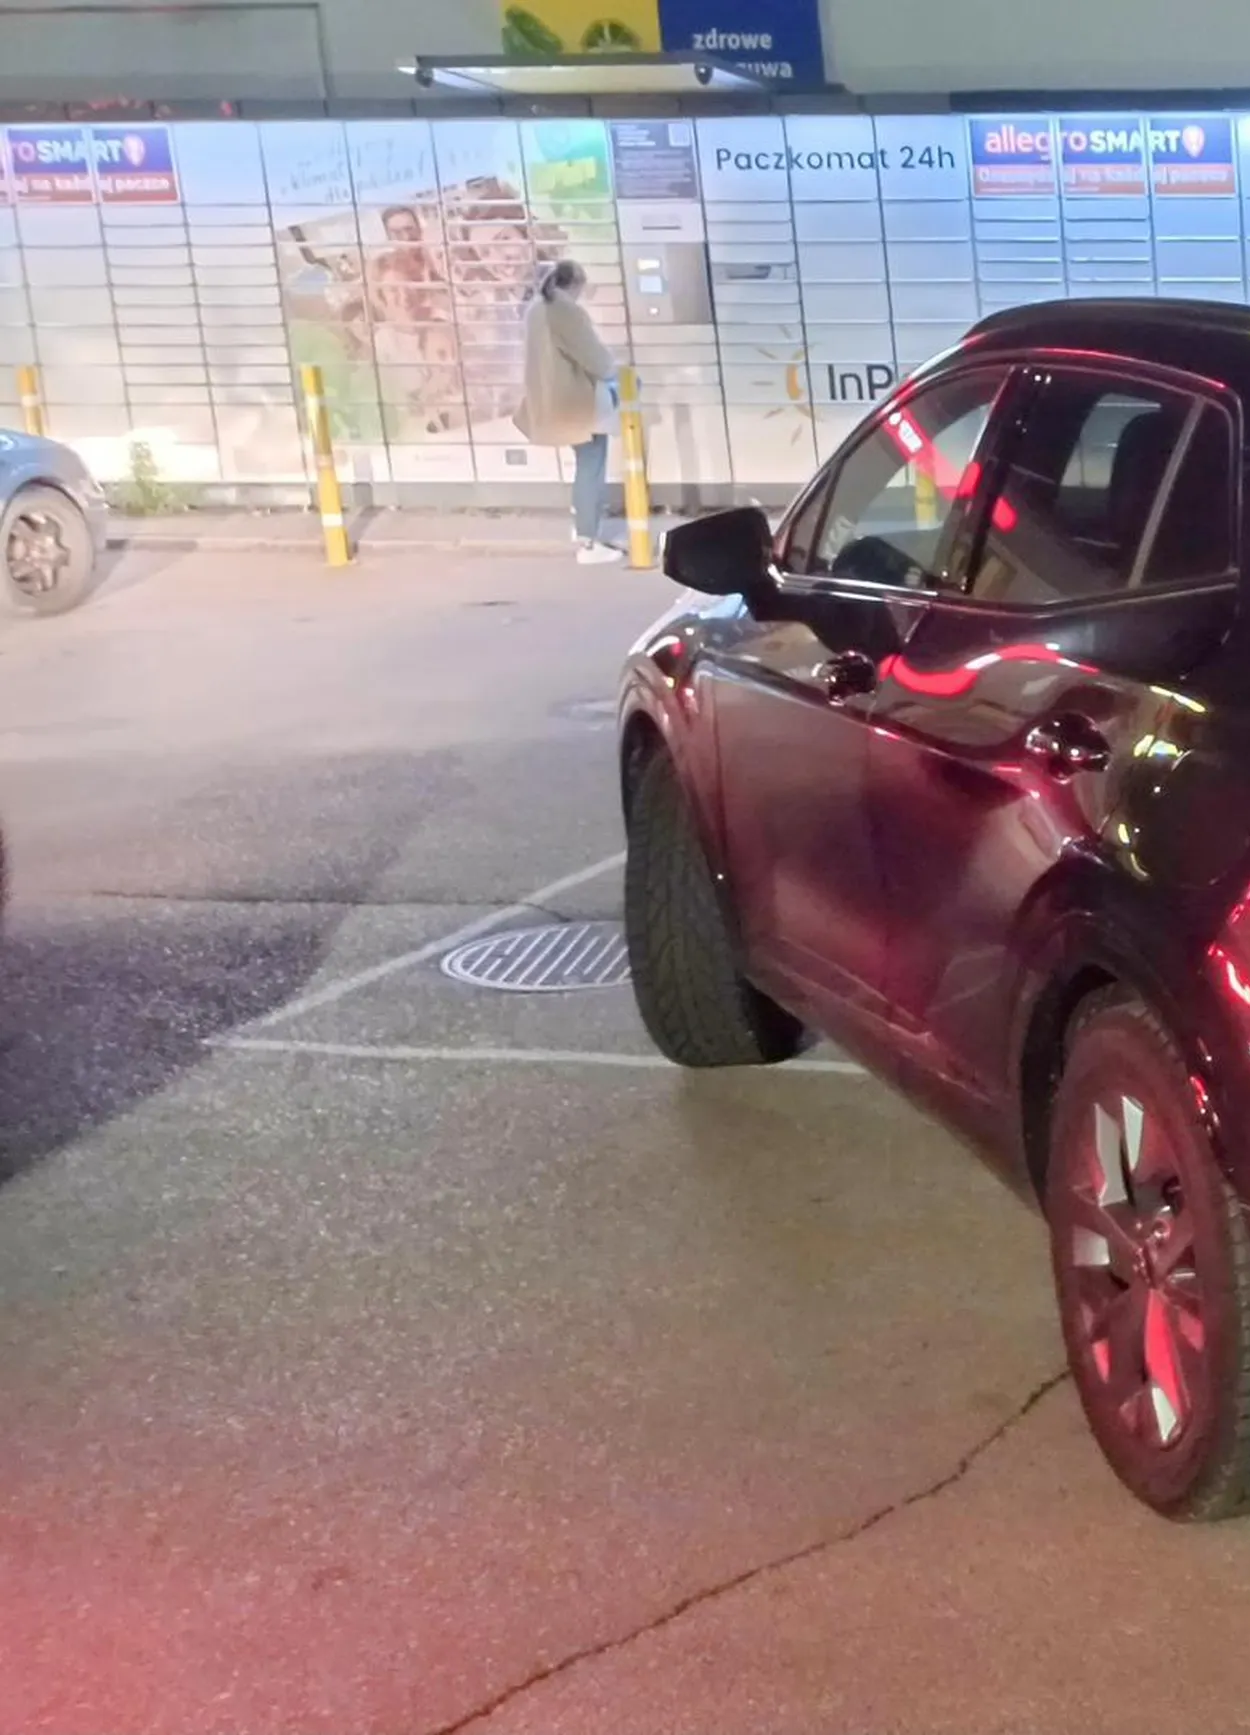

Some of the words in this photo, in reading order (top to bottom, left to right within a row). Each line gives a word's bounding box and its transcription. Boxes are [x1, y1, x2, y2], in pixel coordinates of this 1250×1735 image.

[693, 27, 772, 50] zdrowe
[1089, 129, 1181, 153] SMART
[716, 145, 890, 171] Paczkomat
[900, 145, 955, 170] 24h
[827, 363, 893, 401] InP
